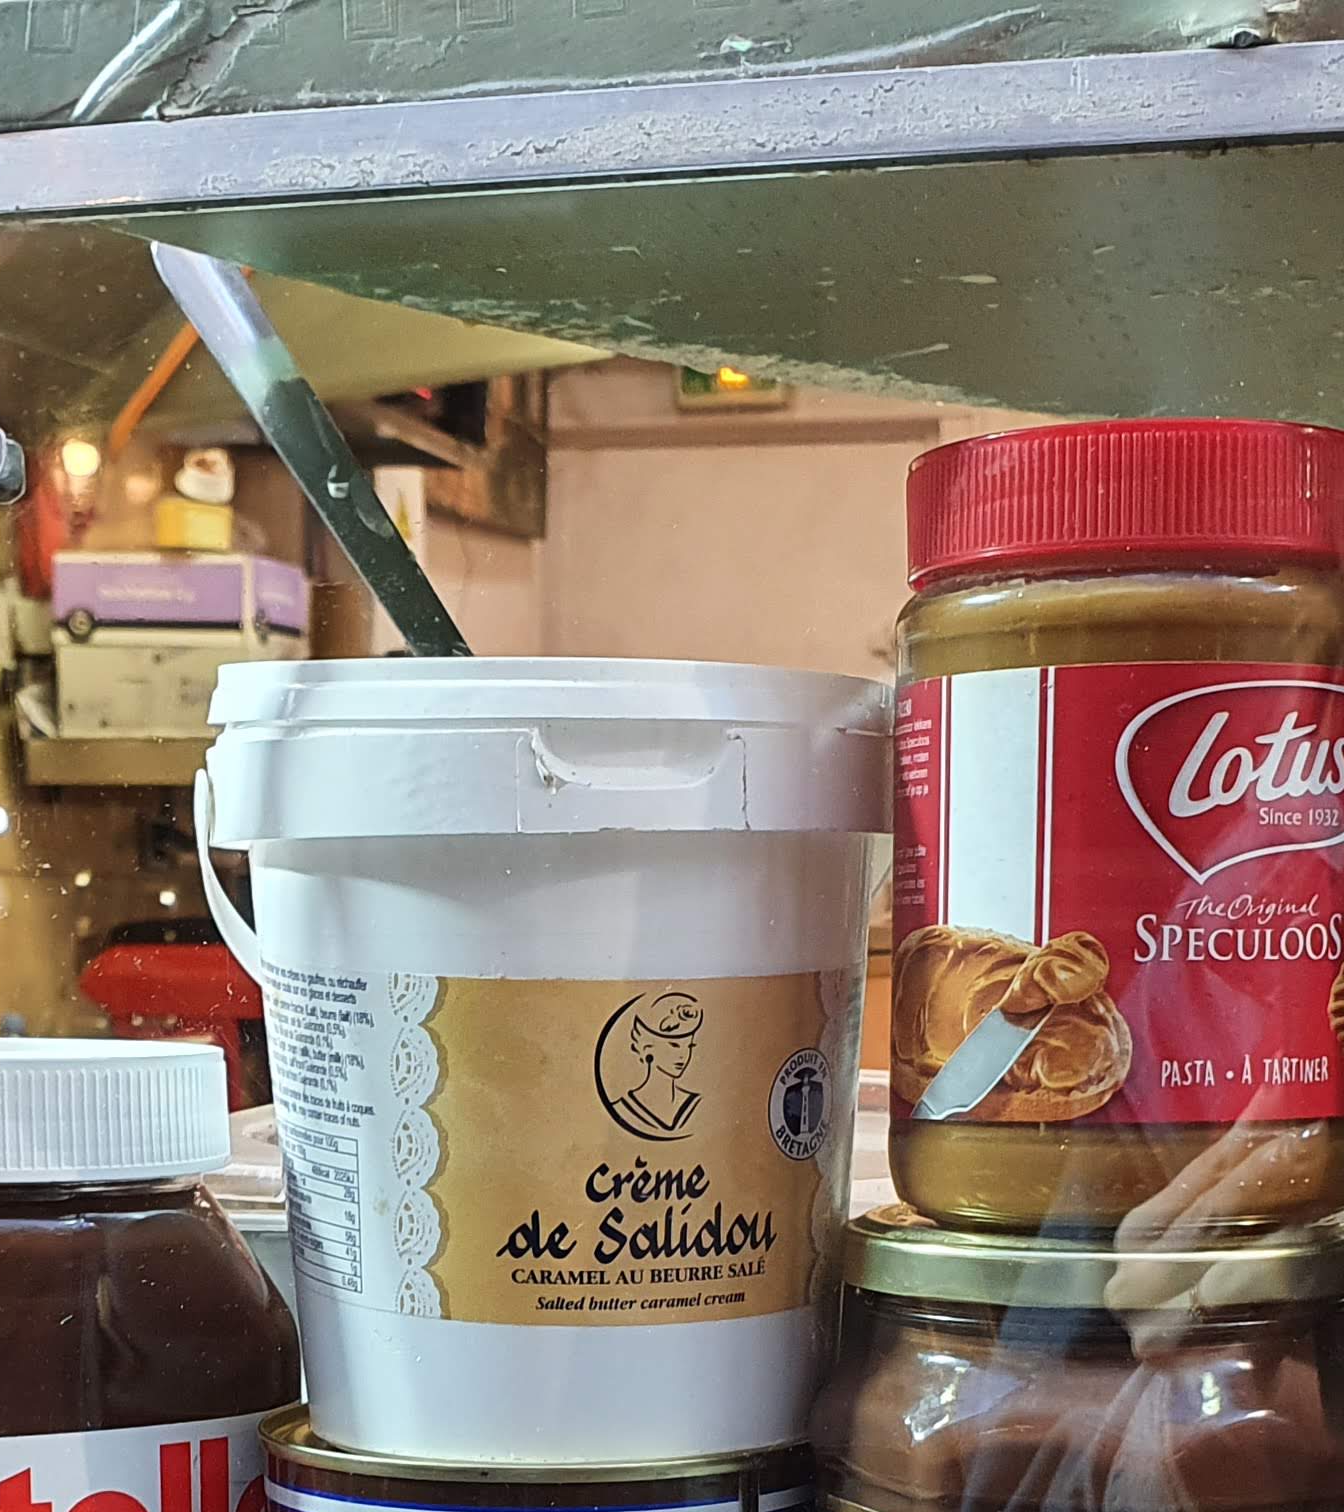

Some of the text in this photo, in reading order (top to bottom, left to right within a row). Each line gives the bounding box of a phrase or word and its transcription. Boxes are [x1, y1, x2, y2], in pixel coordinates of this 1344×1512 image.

[1258, 806, 1340, 827] Since 1932
[1176, 893, 1320, 925] The Original
[1133, 912, 1343, 964] SPECULOOS
[778, 1052, 819, 1085] PRODUIT
[1160, 1053, 1330, 1088] PASTA À TARTINER
[585, 1155, 710, 1203] Crème
[496, 1201, 777, 1265] de Salidou
[511, 1256, 766, 1286] CARAMEL AU BEURRE SALÉ
[535, 1291, 746, 1311] Salted butter caramel cream
